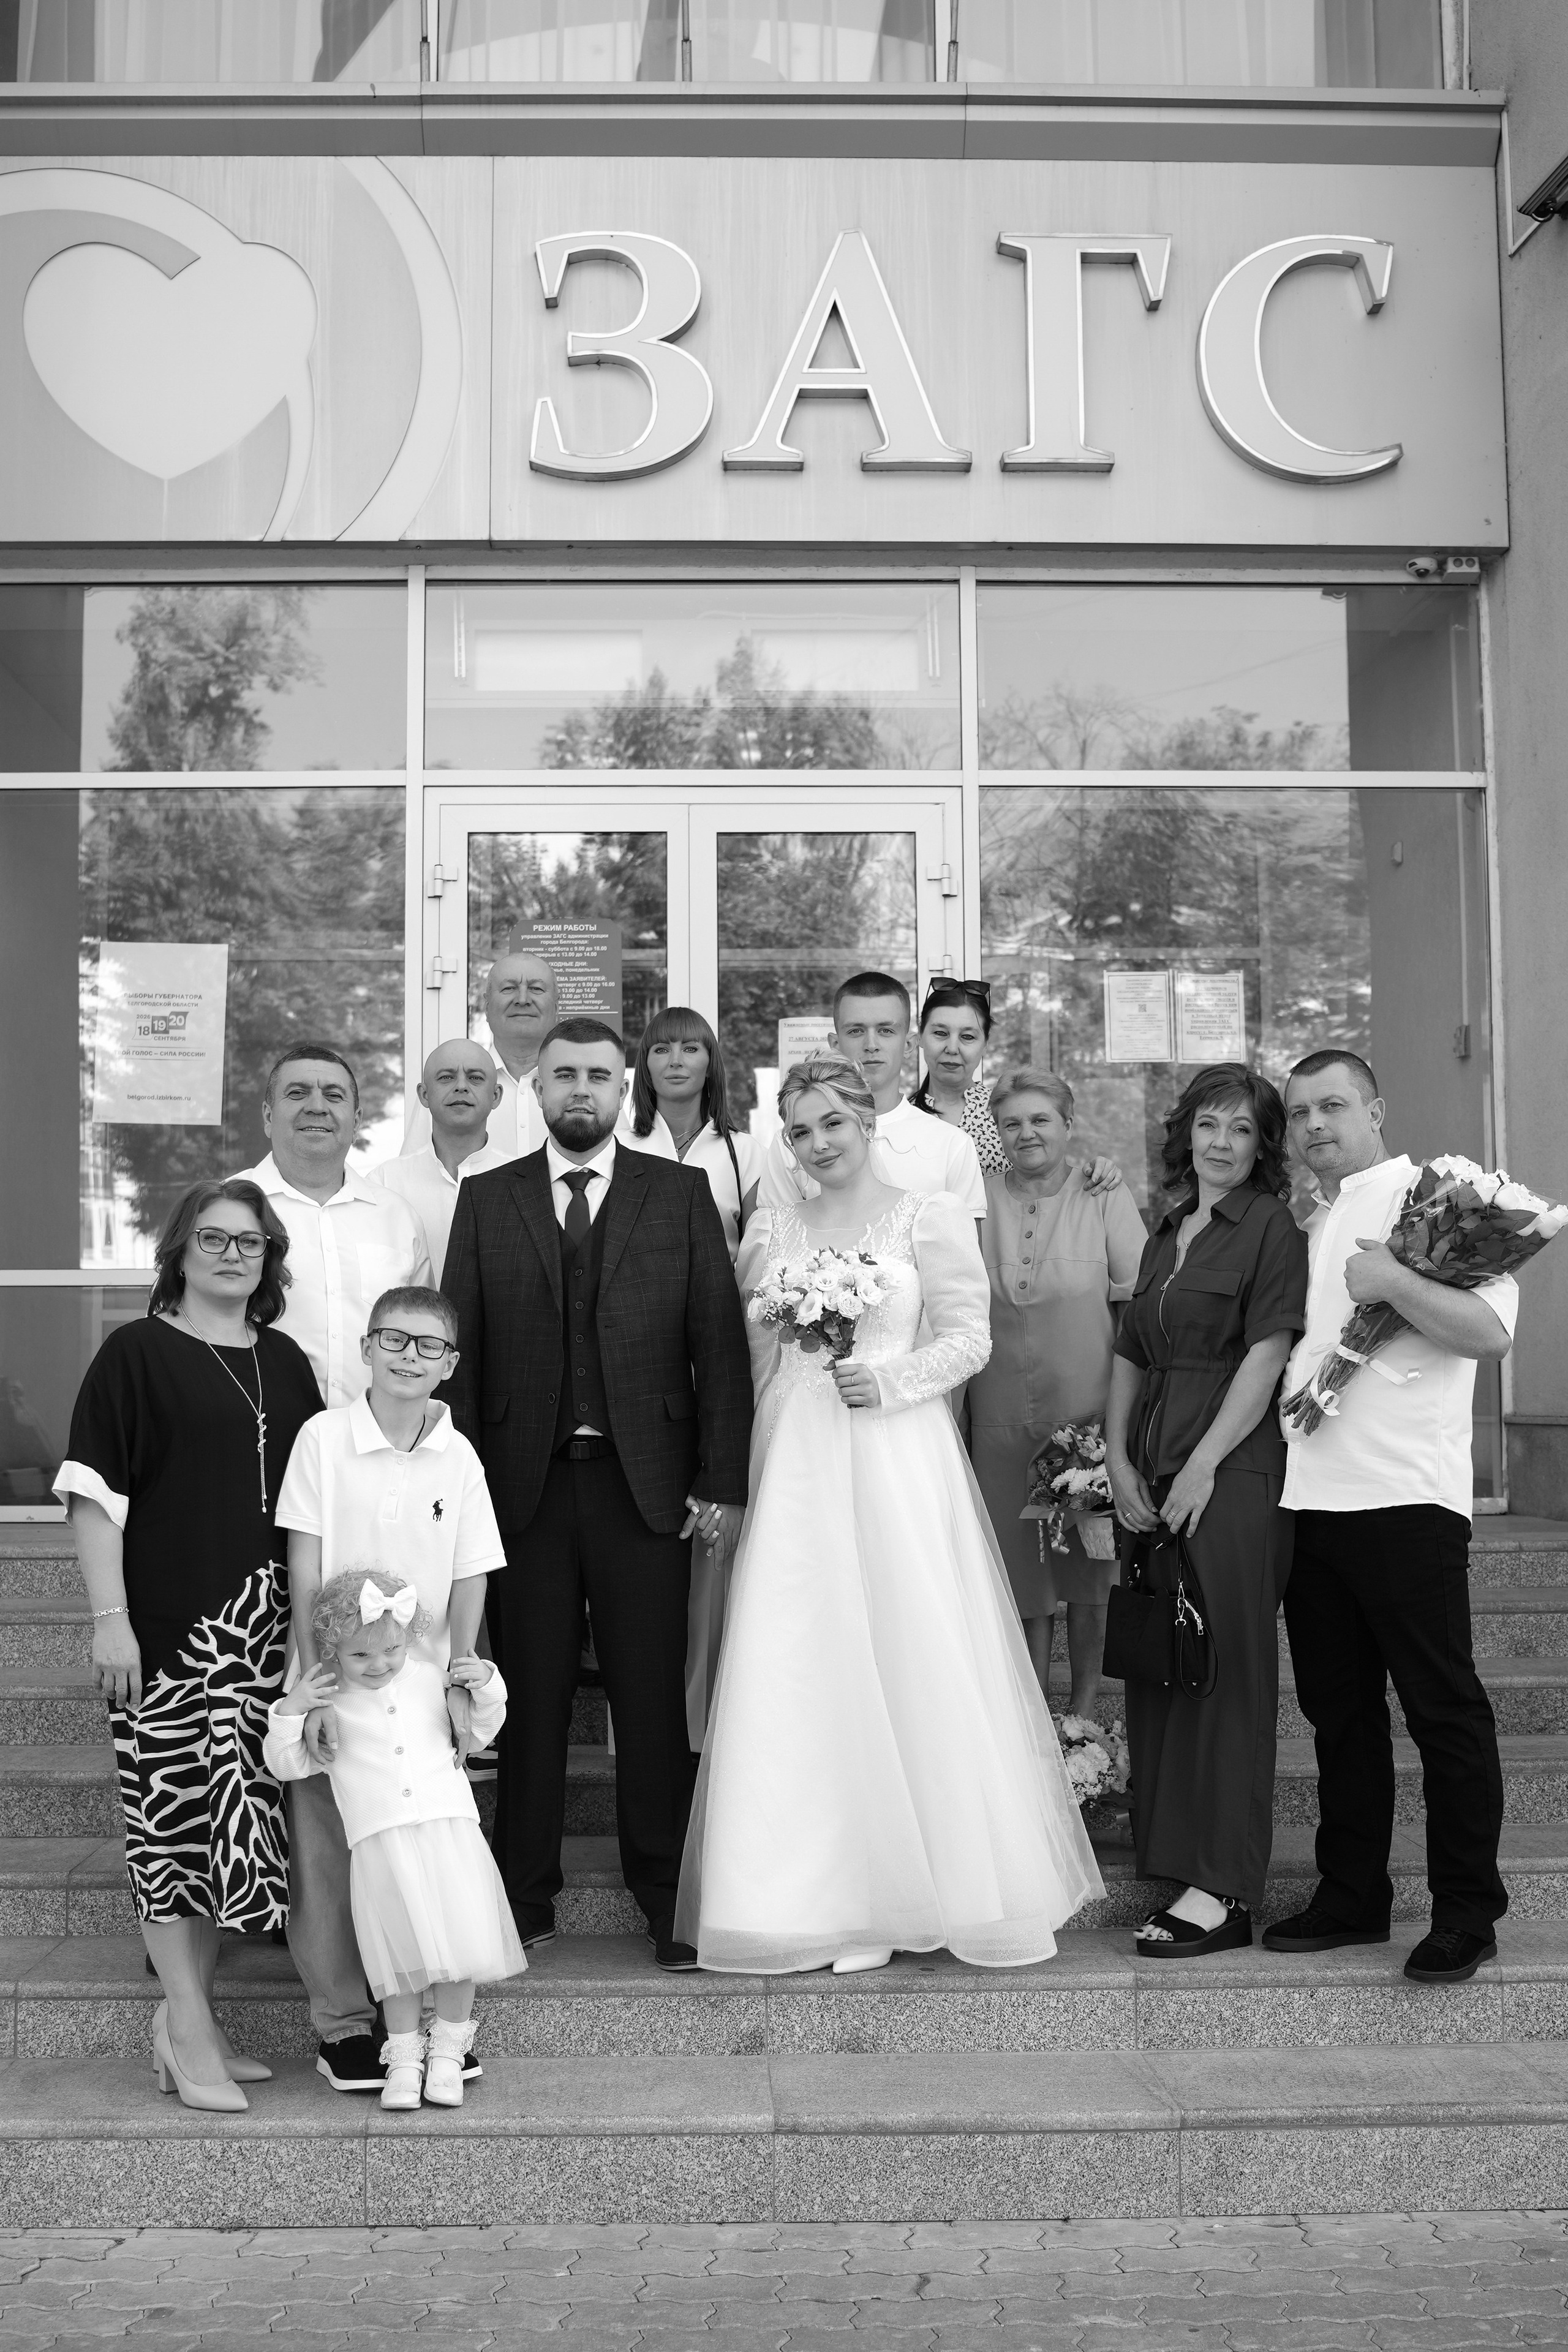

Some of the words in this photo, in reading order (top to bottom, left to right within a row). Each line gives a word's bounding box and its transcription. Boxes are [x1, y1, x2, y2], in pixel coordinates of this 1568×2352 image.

[529, 228, 1404, 485] ЗАГС
[137, 1026, 150, 1036] 18
[153, 1020, 167, 1031] 19
[168, 1015, 185, 1026] 20
